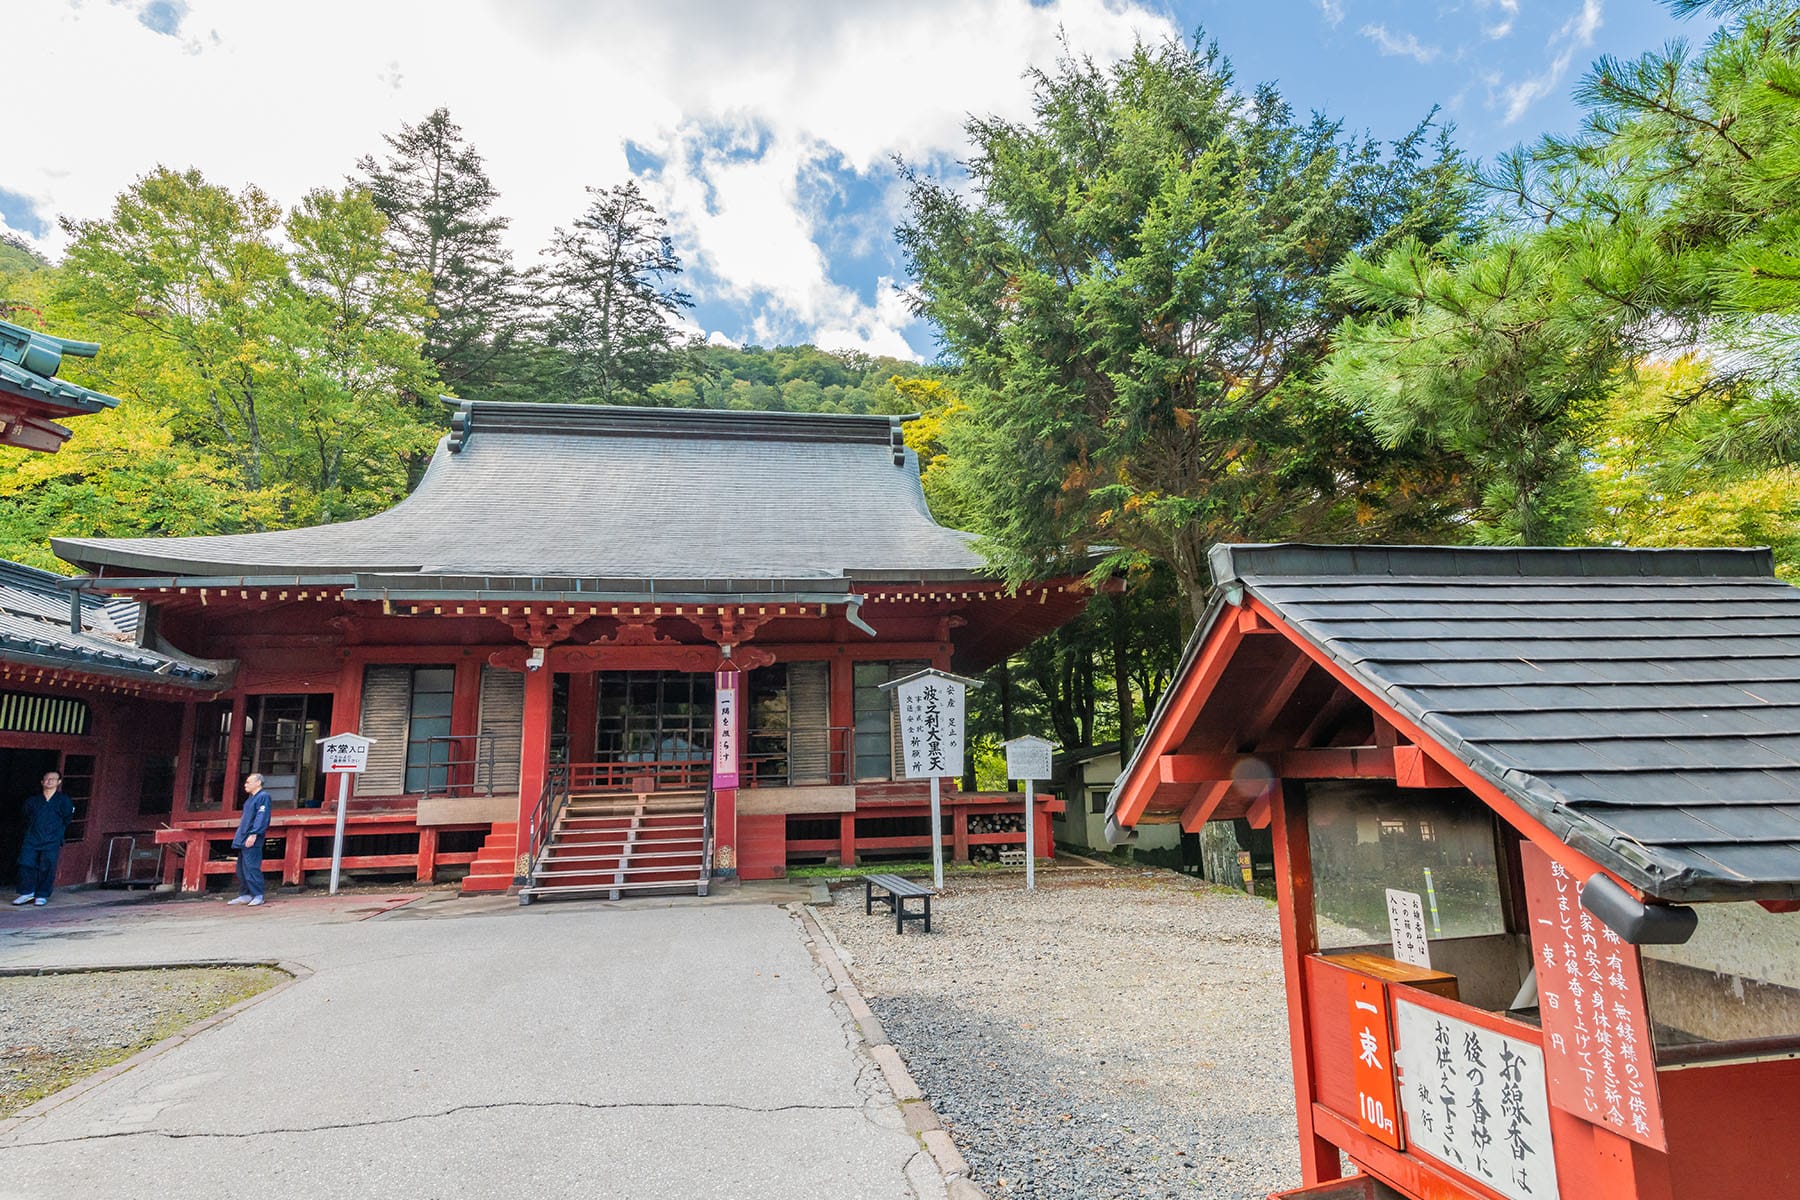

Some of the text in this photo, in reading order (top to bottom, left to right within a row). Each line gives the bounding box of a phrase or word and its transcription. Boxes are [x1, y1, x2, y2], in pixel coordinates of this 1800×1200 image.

[327, 743, 365, 754] 本堂入口
[923, 685, 944, 771] 波之利大黒天
[1390, 895, 1403, 959] 入れて下さい
[1355, 999, 1383, 1070] 一束
[1359, 1091, 1394, 1135] 100円
[1463, 1031, 1494, 1178] 後の香炉に
[1499, 1040, 1536, 1194] お線香は
